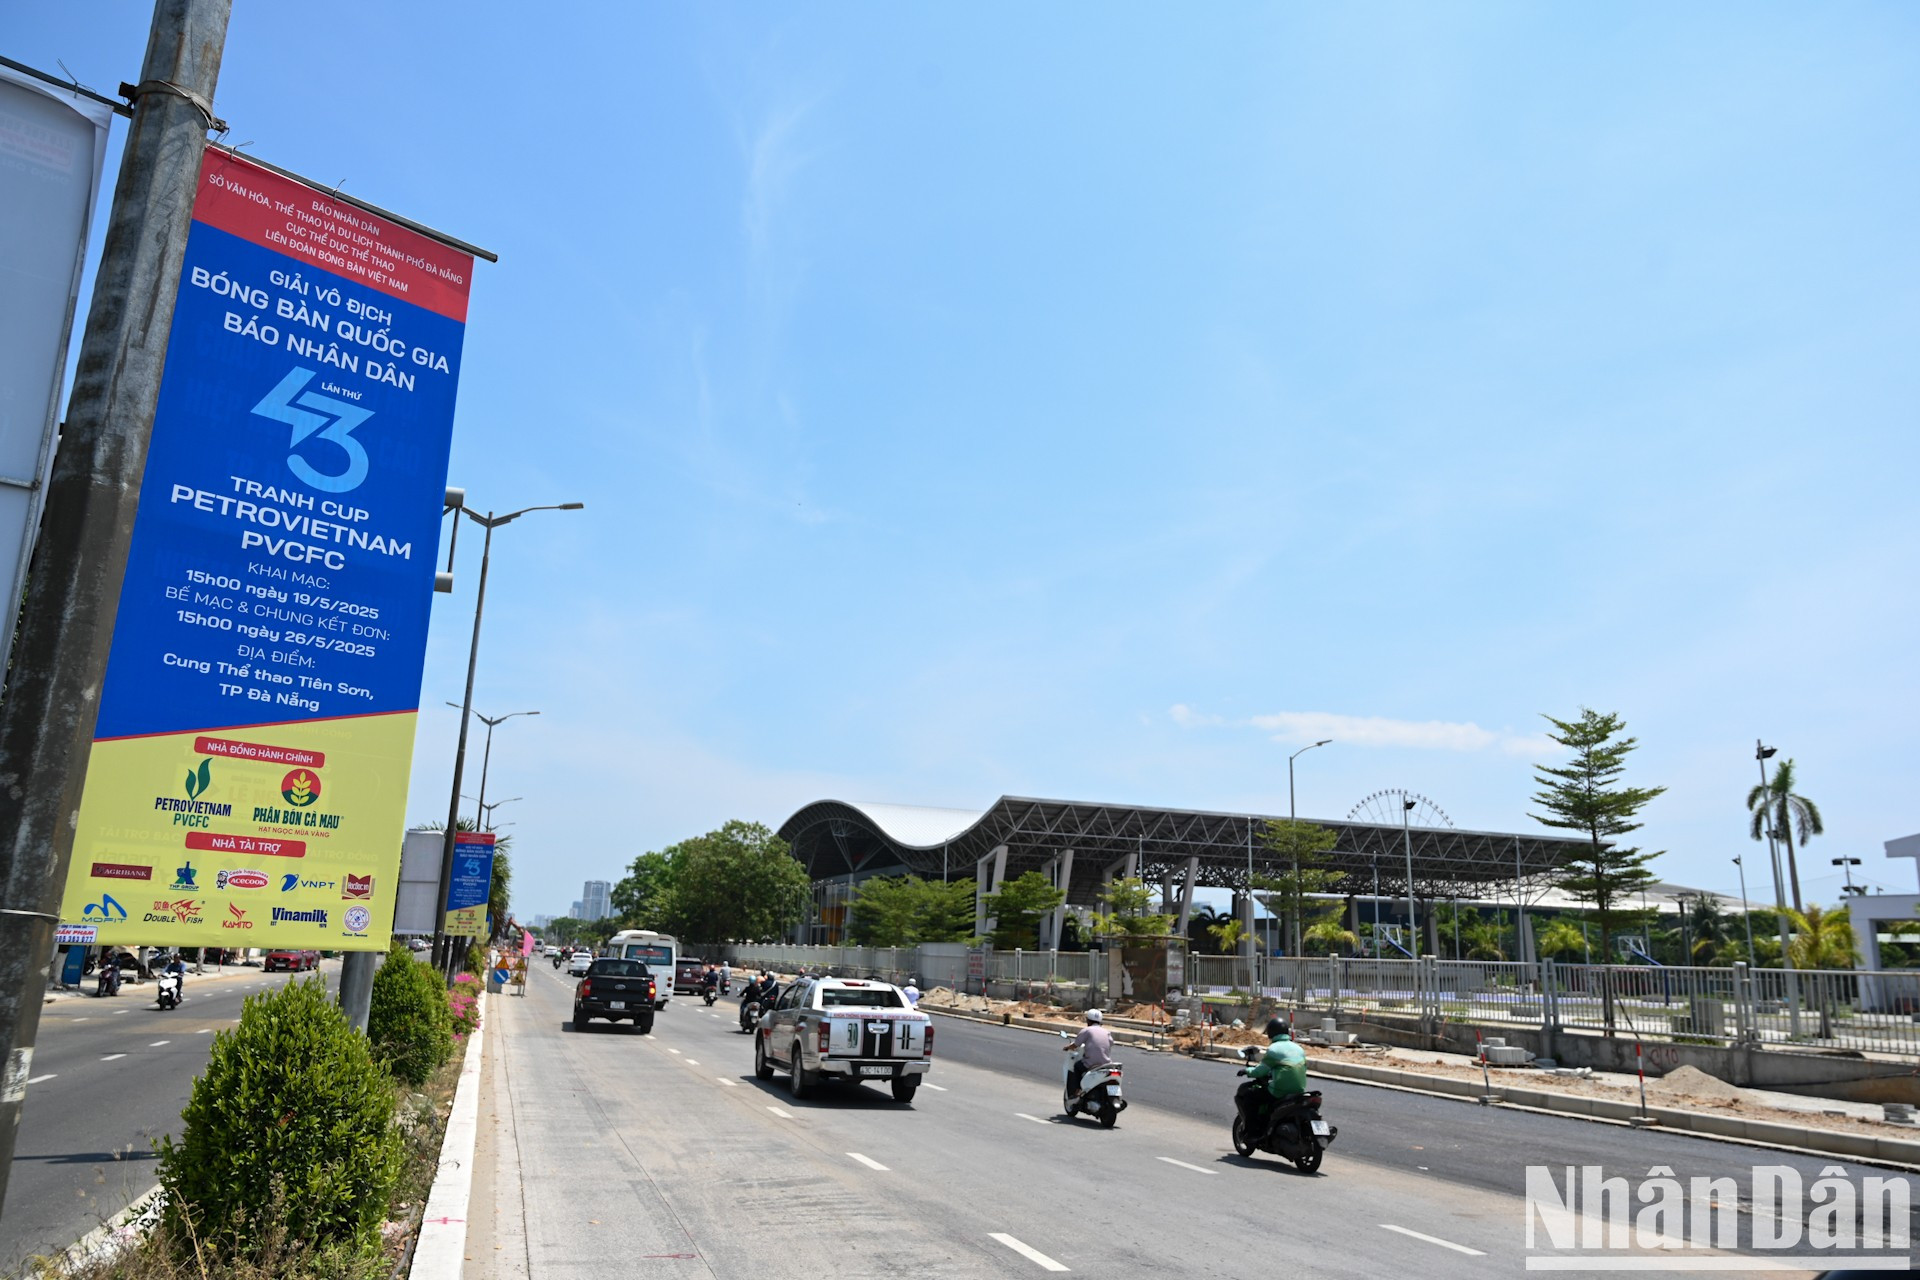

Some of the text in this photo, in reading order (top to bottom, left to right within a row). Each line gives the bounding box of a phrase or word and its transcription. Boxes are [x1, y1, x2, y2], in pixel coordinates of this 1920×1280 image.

[208, 174, 463, 284] SỞ VĂN HÓA, THỂ THAO VÀ DU LỊCH THÀNH PHỐ ĐÀ NẴNG
[312, 201, 380, 236] BÁO NHÂN DÂN
[266, 229, 409, 292] LIÊN ĐOÀN BÓNG BÀN VIỆT NAM
[286, 222, 395, 272] CỤC THỂ DỤC THỂ THAO
[270, 269, 392, 326] GIẢI VÔ ĐỊCH
[190, 265, 450, 374] BÓNG BÀN QUỐC GIA
[224, 311, 416, 392] BÁO NHÂN DÂN
[342, 388, 362, 400] THỨ
[230, 476, 370, 523] TRANH CUP
[170, 484, 412, 560] PETROVIETNAM
[241, 530, 346, 570] PVCFC
[248, 562, 330, 590] KHAI MẠC:
[186, 569, 380, 619] 15h00 ngày 19/5/2025
[166, 585, 390, 640] BẾ MẠC & CHUNG KẾT ĐƠN:
[176, 610, 376, 658] 15h00 ngày 26/5/2025
[237, 644, 316, 669] ĐỊA ĐIỂM:
[163, 652, 374, 700] Cung Thể thao Tiên Sơn,
[218, 683, 320, 712] TP Đà Nẵng
[207, 742, 228, 754] NHÀ
[230, 743, 256, 757] ĐỒNG
[258, 748, 284, 760] HÀNH
[285, 751, 313, 764] CHÍNH
[154, 797, 232, 817] PETROVIETNAM
[173, 813, 210, 829] PVCFC
[252, 806, 340, 830] PHÂN BÓN CÀ MAU
[212, 838, 282, 852] NHÀ TÀI TRỢ
[272, 827, 294, 836] NGỌC
[294, 828, 309, 836] MÙA
[310, 830, 330, 838] VÀNG
[104, 868, 147, 877] AGRIBANK
[300, 880, 336, 889] VNPT
[82, 916, 126, 924] MOFIT
[222, 920, 253, 929] KAMITO
[272, 907, 328, 922] Vinamilk
